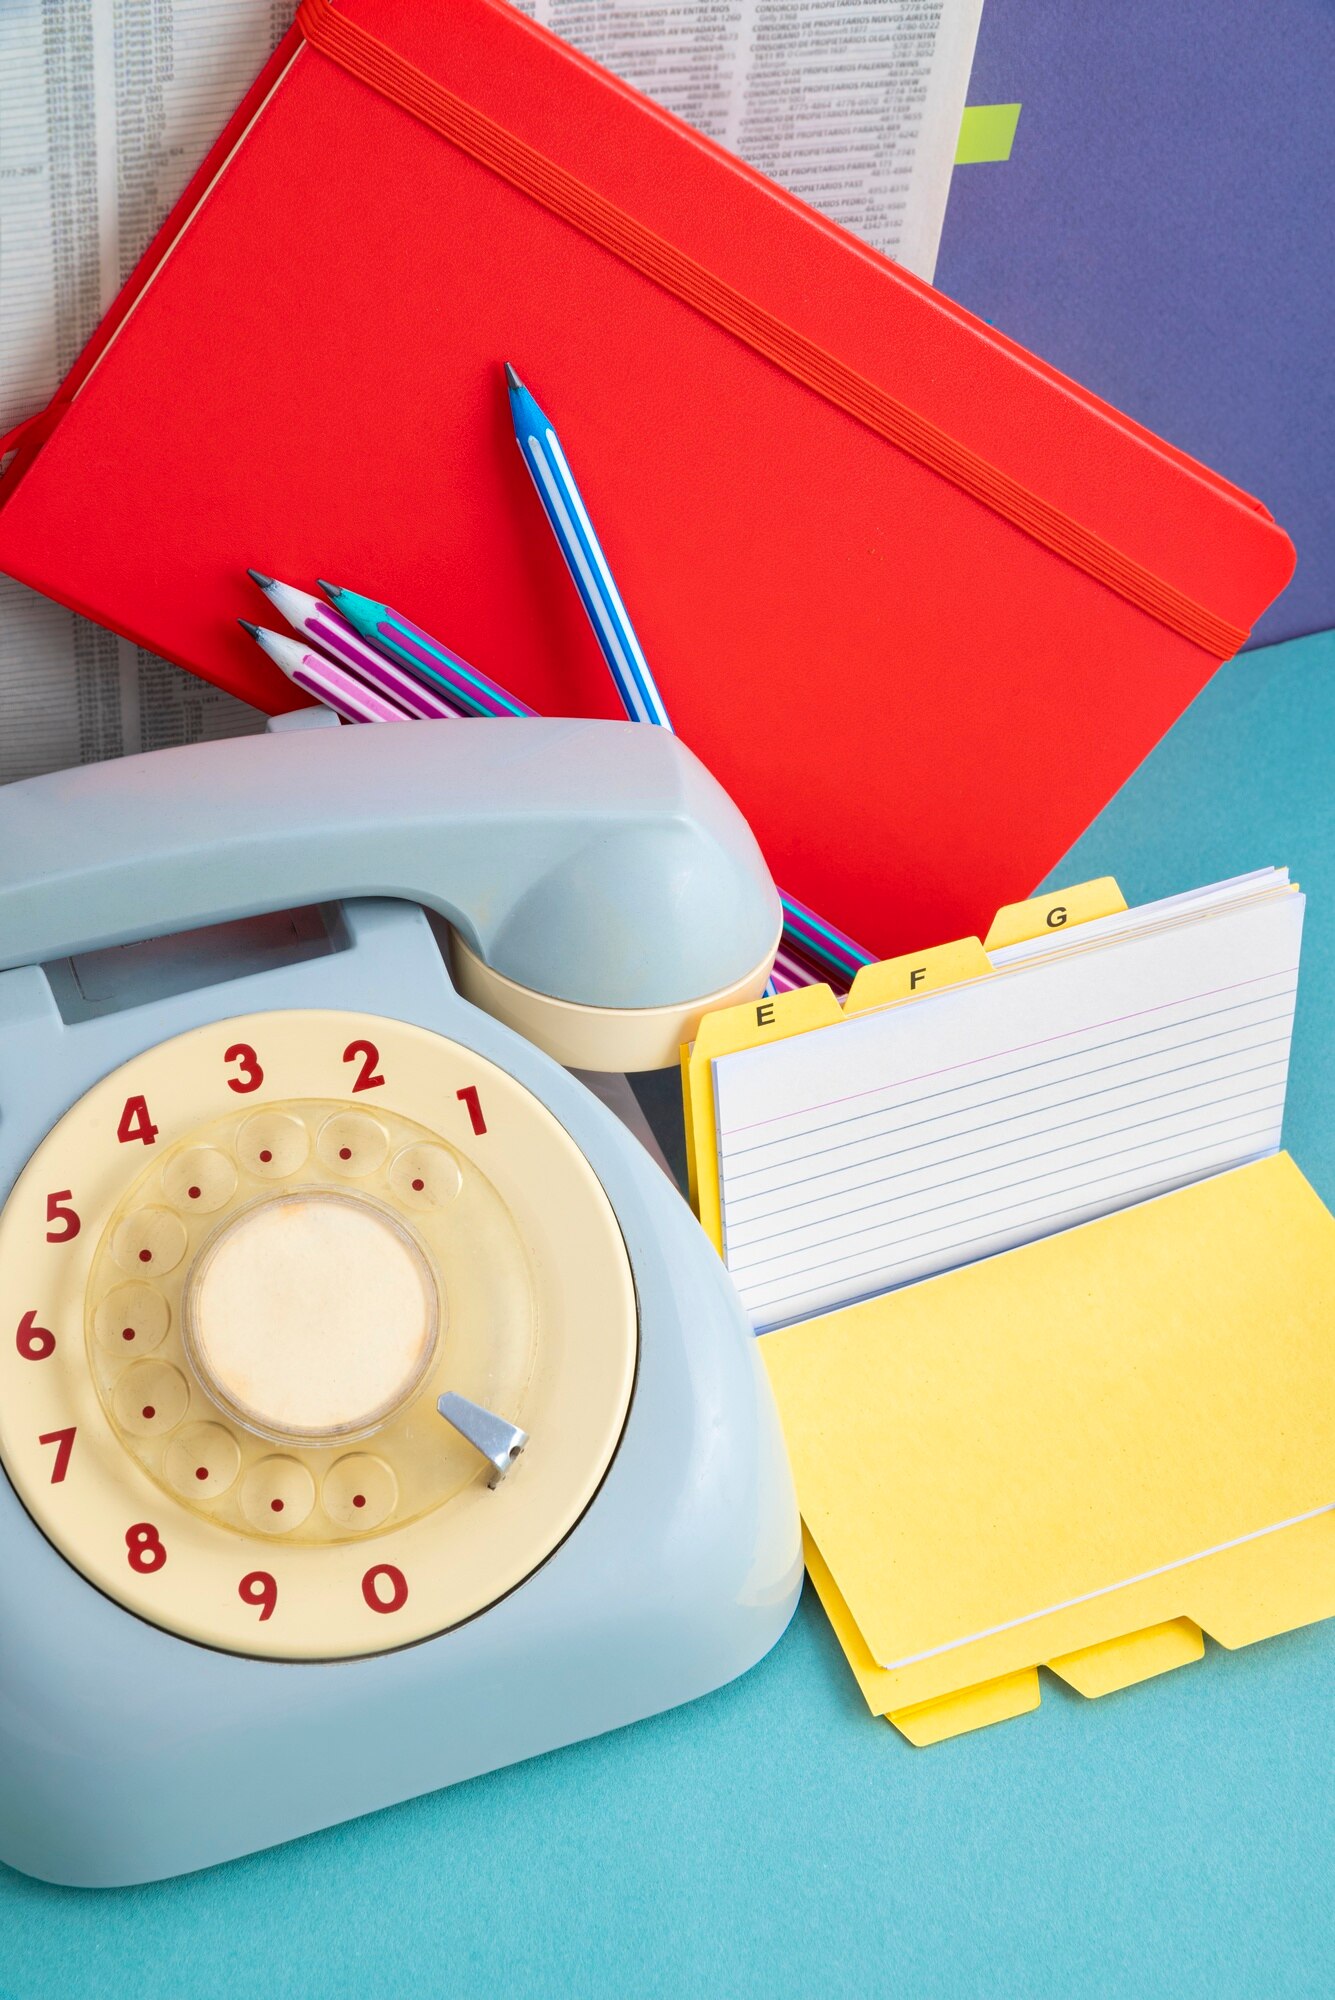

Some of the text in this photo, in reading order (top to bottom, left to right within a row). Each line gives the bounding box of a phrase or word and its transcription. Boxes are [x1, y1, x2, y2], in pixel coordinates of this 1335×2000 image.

[548, 5, 730, 26] CONSORCIO DE PROPIETARIOS AV ENTRE RIOS
[756, 4, 798, 14] CONSORCIO
[800, 4, 810, 12] DE
[812, 2, 861, 10] PROPIETARIOS
[595, 34, 606, 42] DE
[608, 29, 665, 40] PROPIETARIOS
[679, 24, 726, 34] RIVADAVIA
[752, 23, 800, 32] CONSORCIO
[814, 18, 870, 28] PROPIETARIOS
[871, 16, 904, 24] NUEVOS
[906, 14, 928, 22] AIRES
[750, 32, 936, 52] CONSORCIO DE PROPIETARIOS OLGA COSSENTIN
[756, 32, 800, 42] BELGRANO
[606, 49, 664, 60] PROPIETARIOS
[746, 70, 790, 80] CONSORCIO
[803, 65, 856, 75] PROPIETARIOS
[858, 62, 893, 72] PALERMO
[894, 60, 919, 68] TWINS
[744, 88, 790, 98] CONSORCIO
[791, 86, 802, 94] DE
[803, 82, 859, 94] PROPIETARIOS
[860, 80, 898, 90] PALERMO
[740, 108, 890, 126] CONSORCIO DE PROPIETARIOS PARAGUAY
[738, 134, 782, 144] CONSORCIO
[784, 132, 794, 140] DE
[796, 128, 852, 139] PROPIETARIOS
[782, 146, 848, 158] DE PROPIETARIOS
[779, 169, 789, 177] DE
[791, 164, 846, 176] PROPIETARIOS
[789, 182, 843, 192] PROPIETARIOS
[842, 198, 866, 206] PEDRO
[1046, 906, 1067, 928] G
[910, 968, 926, 990] F
[756, 1003, 776, 1026] E
[225, 1044, 263, 1093] 3
[343, 1040, 384, 1092] 2
[118, 1096, 158, 1145] 4
[457, 1086, 486, 1135] 1
[47, 1190, 80, 1242] 5
[17, 1311, 55, 1360] 6
[39, 1428, 76, 1483] 7
[126, 1523, 166, 1573] 8
[239, 1572, 277, 1620] 9
[362, 1564, 408, 1613] 0
